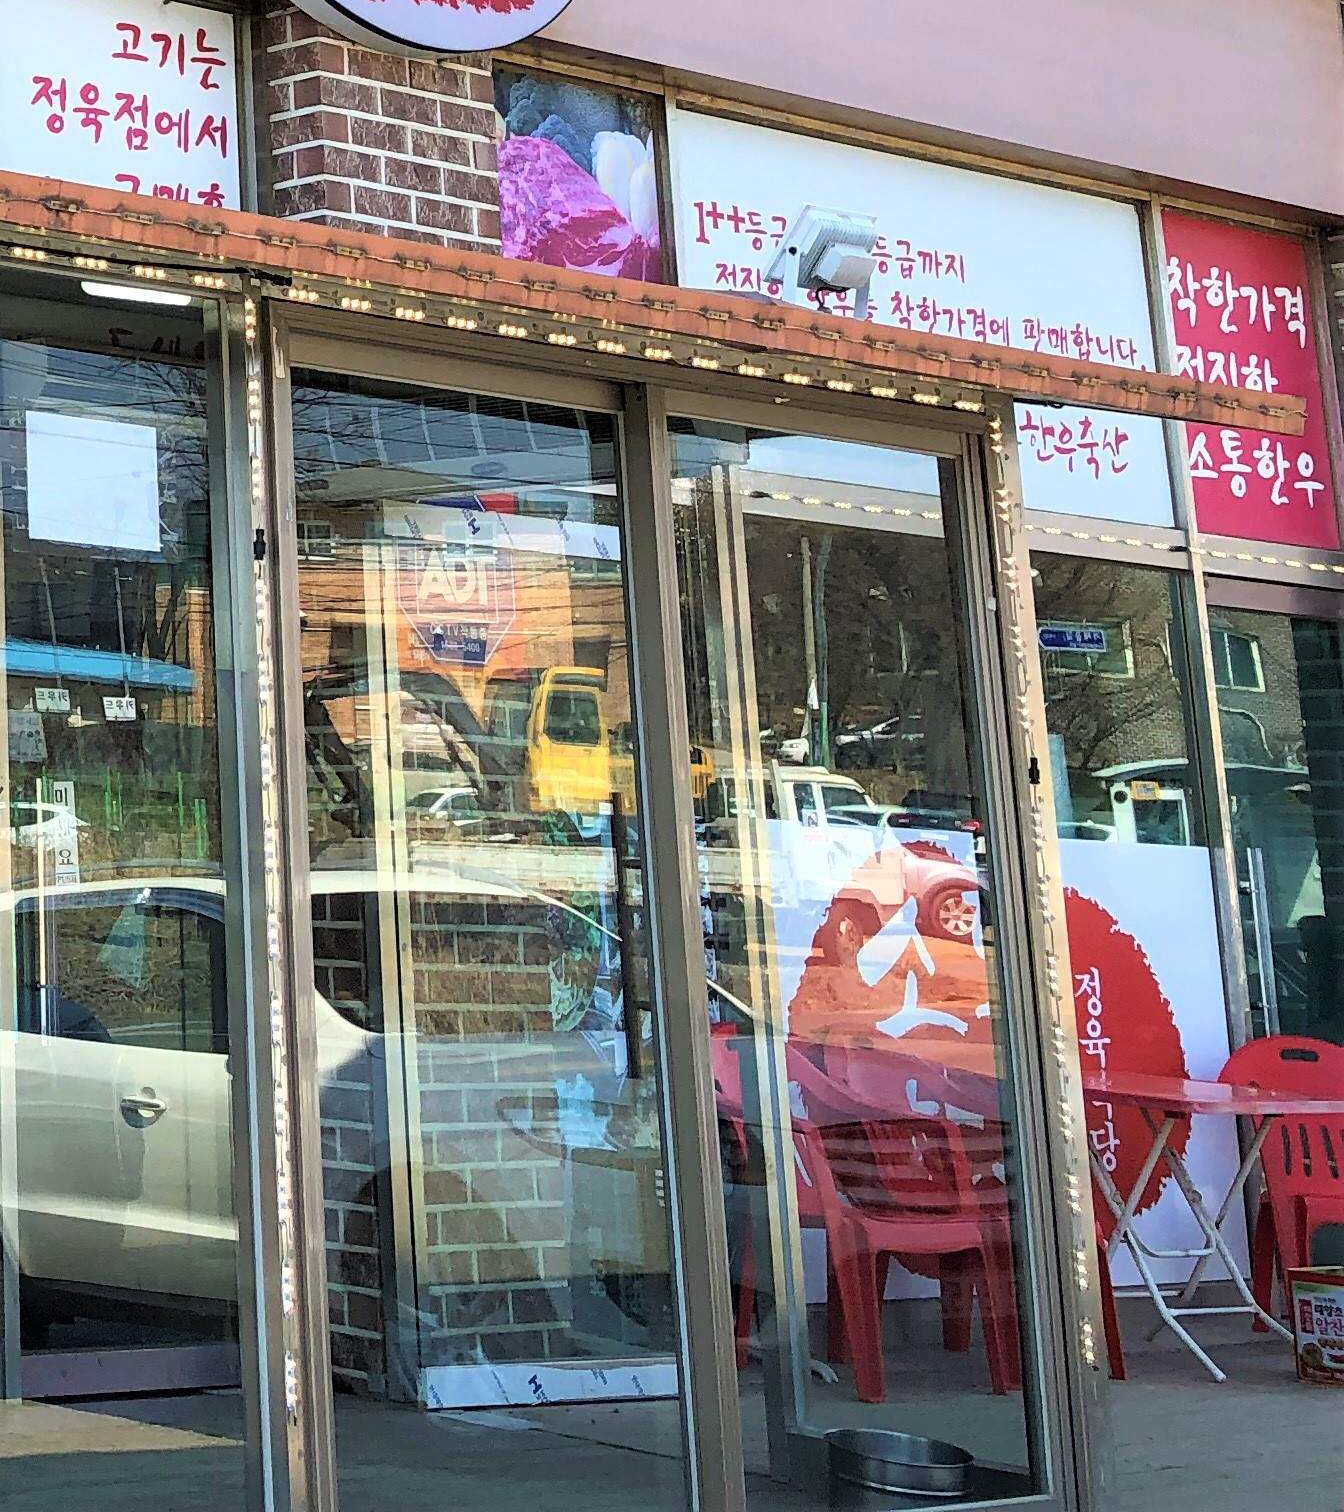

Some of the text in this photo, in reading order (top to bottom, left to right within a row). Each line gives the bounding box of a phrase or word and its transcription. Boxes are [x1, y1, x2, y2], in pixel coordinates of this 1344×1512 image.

[111, 21, 227, 88] 고기는
[30, 74, 229, 160] 정육점에서
[1166, 256, 1307, 349] 착한가격
[1017, 409, 1130, 481] 한우축산
[1189, 429, 1326, 508] 소통한우
